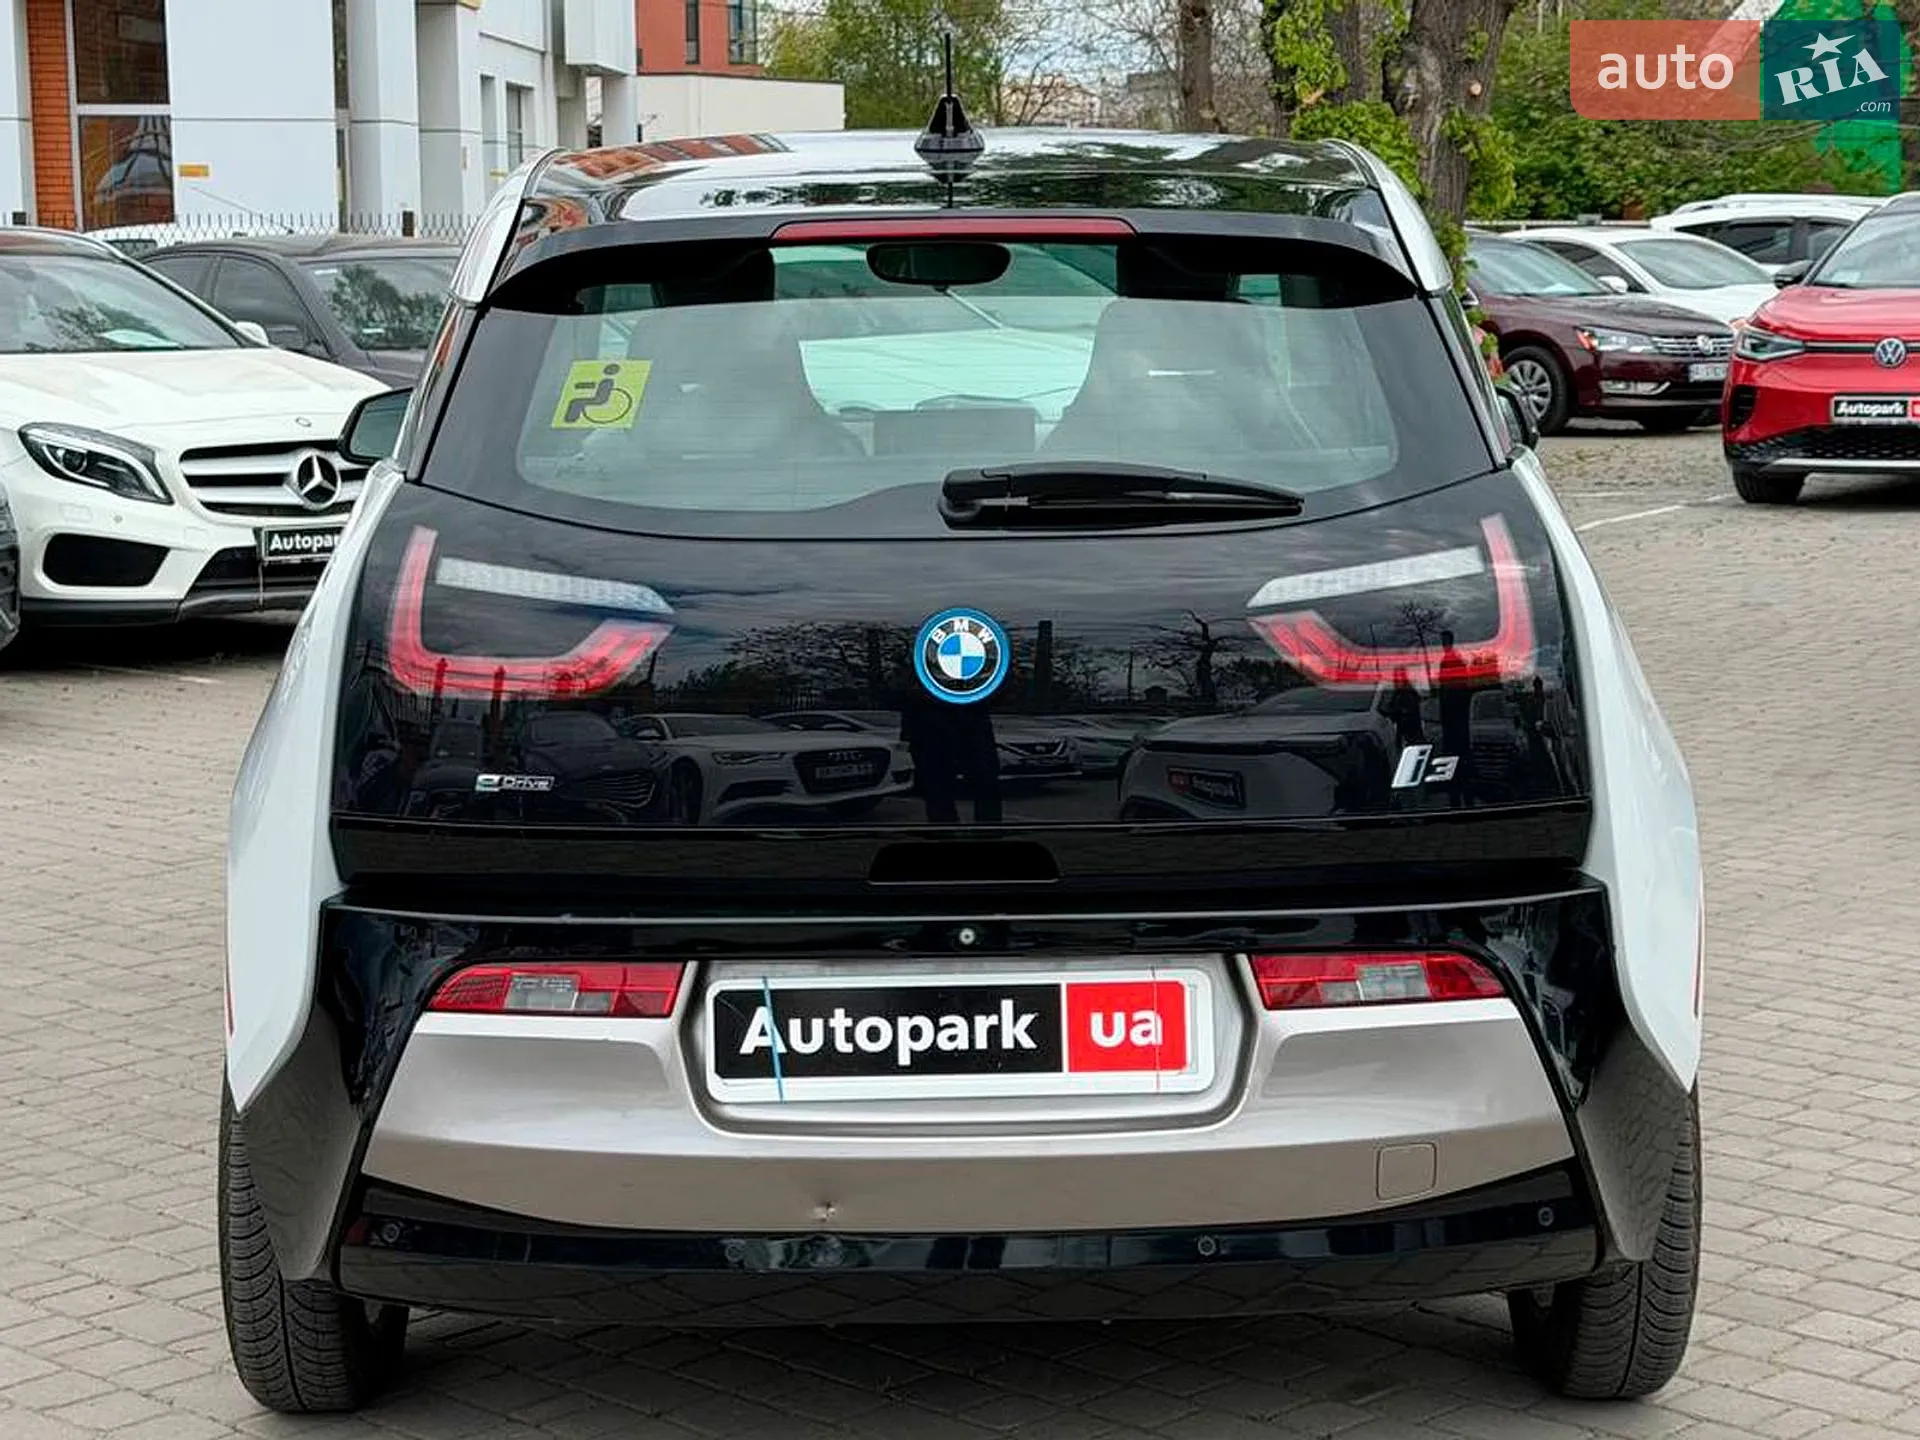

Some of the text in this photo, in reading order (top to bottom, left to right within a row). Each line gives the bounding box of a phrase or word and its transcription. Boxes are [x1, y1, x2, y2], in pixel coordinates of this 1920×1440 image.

[1836, 402, 1904, 417] Autopark
[269, 532, 341, 552] Autopar
[931, 618, 995, 645] BMW
[739, 999, 1164, 1067] Autopark ua
